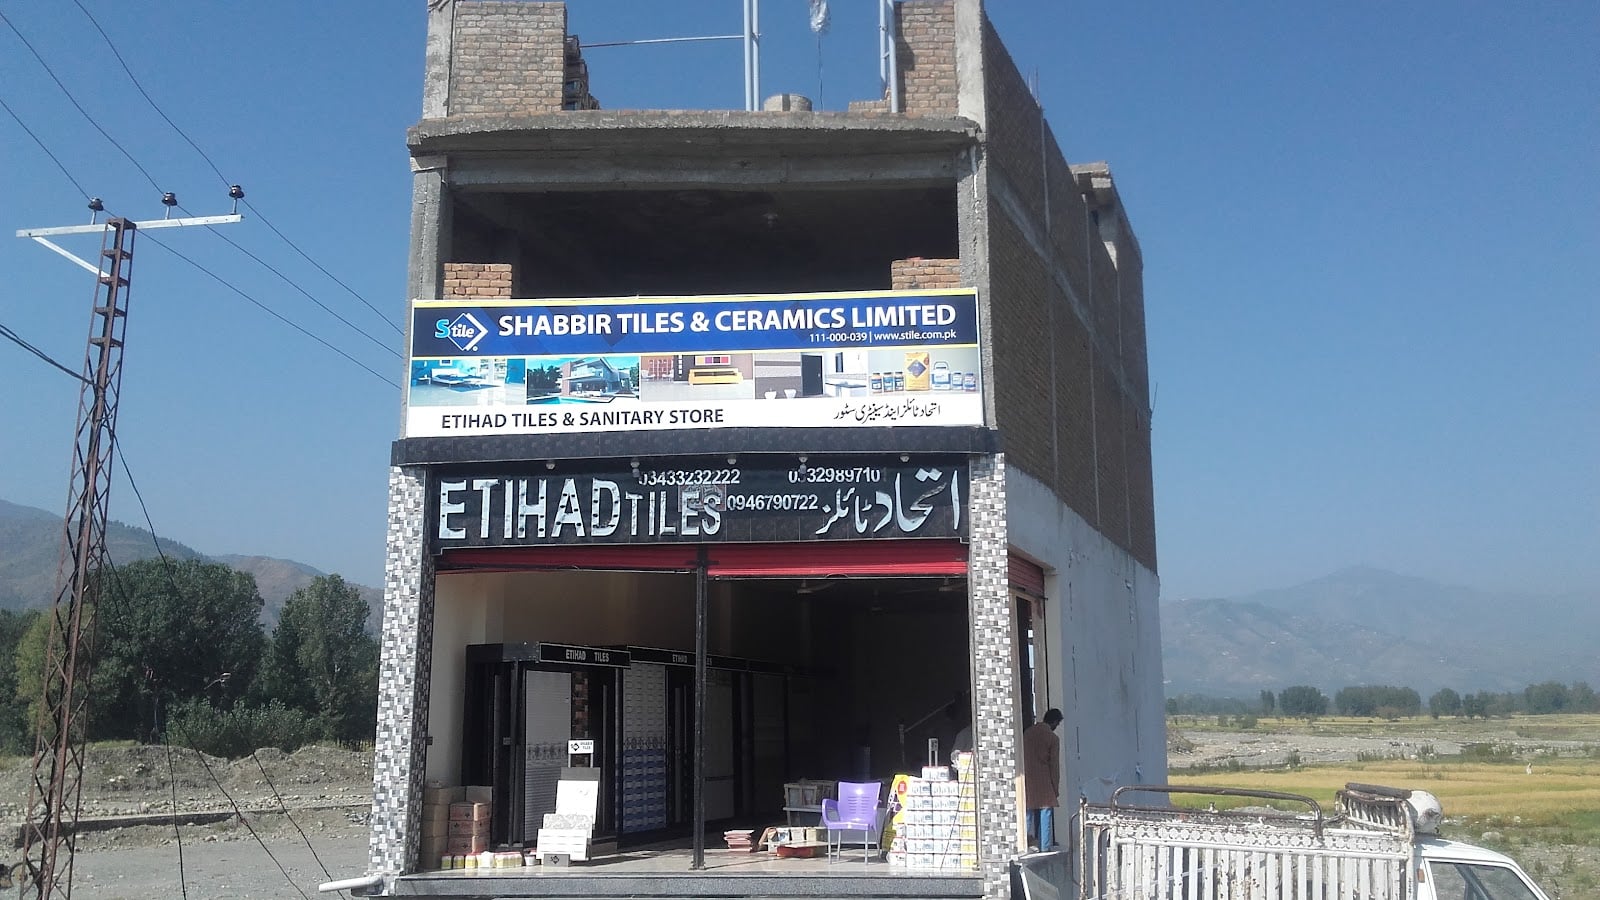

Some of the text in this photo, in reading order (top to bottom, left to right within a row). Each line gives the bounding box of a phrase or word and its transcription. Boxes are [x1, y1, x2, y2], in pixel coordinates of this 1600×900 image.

[498, 304, 956, 336] SHABBIR TILES & CERAMICS LIMITED
[809, 332, 867, 343] 111-000-039
[874, 329, 957, 342] www.stile.com.pk
[441, 409, 724, 429] ETIHAD TILES & SANITARY STORE
[919, 402, 941, 418] اتحاد
[438, 477, 622, 540] ETIHAD
[624, 489, 722, 536] TILES
[727, 494, 818, 511] 0946790722
[873, 467, 961, 533] اتحاد
[565, 649, 610, 663] ETIHAD TILES
